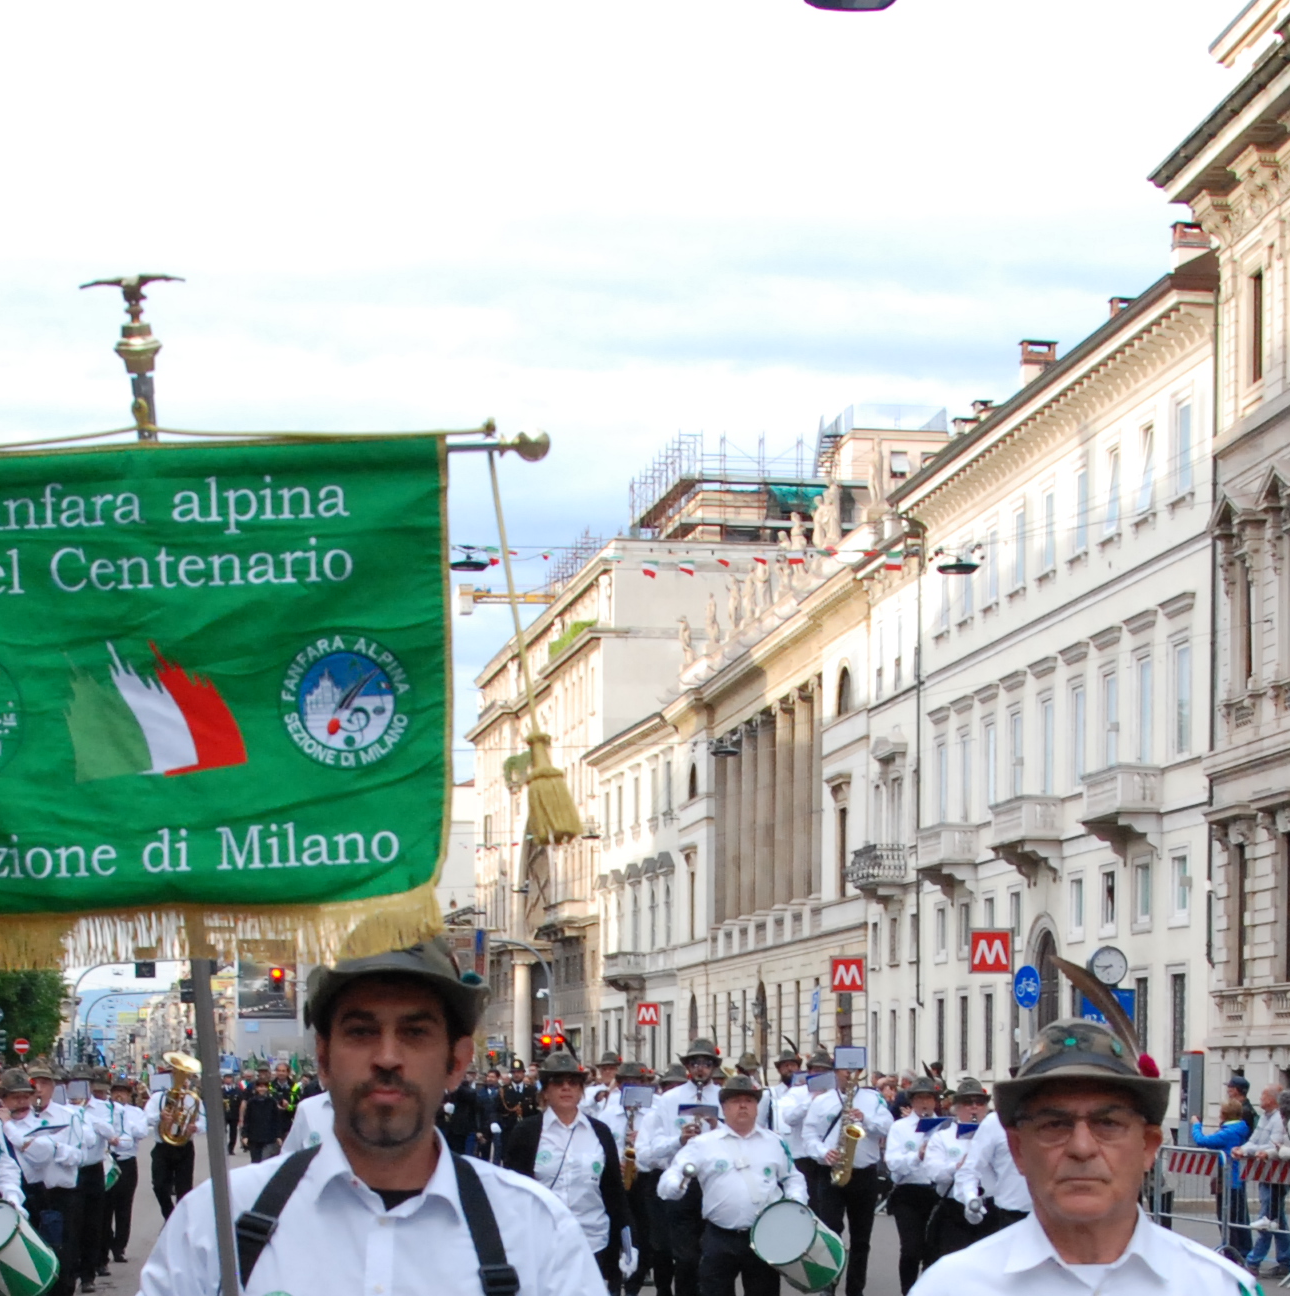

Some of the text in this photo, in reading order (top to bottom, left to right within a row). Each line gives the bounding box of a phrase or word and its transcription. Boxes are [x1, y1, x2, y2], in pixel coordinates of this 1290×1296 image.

[172, 475, 350, 534] alpina
[50, 537, 353, 592] Centenario
[281, 635, 410, 701] FANFARA ALPINA
[284, 712, 408, 767] SEZIONE DI MILANO
[142, 827, 191, 873] di
[216, 822, 400, 870] Milano
[833, 964, 863, 986] M
[973, 938, 1008, 965] M
[638, 1006, 658, 1022] M
